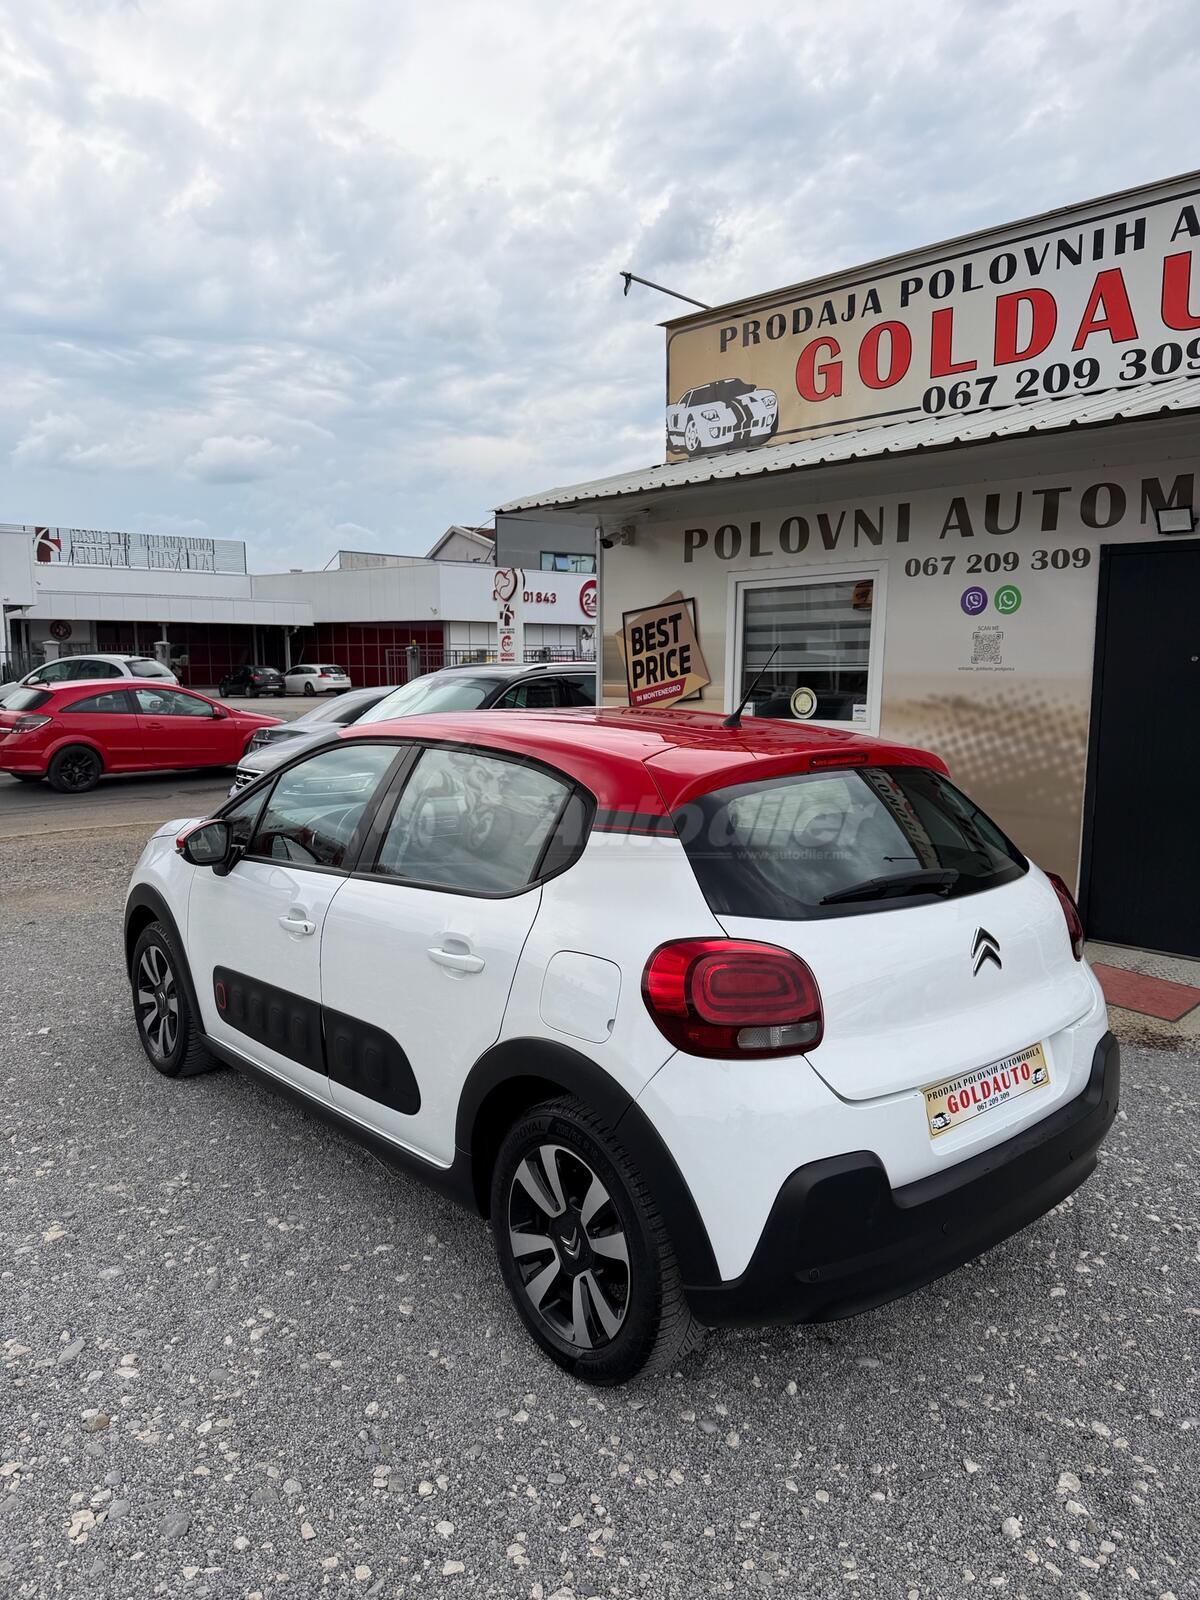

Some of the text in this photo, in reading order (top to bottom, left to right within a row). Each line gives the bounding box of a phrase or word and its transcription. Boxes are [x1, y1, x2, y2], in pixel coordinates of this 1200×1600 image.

[719, 288, 882, 353] PRODAJA
[900, 216, 1146, 308] POLOVNIH
[921, 375, 998, 414] 067
[1015, 357, 1101, 399] 209
[683, 473, 1195, 563] POLOVNI AUTOM
[904, 546, 1092, 577] 067 209 309
[631, 612, 682, 657] BEST
[632, 643, 692, 689] PRICE
[643, 684, 681, 701] MONTENEGRO
[927, 1047, 1041, 1102] PRODAJA POLOVNIH AUTOMOBILA
[947, 1062, 1031, 1114] GOLDAUTO
[976, 1091, 1010, 1112] 067 209 309
